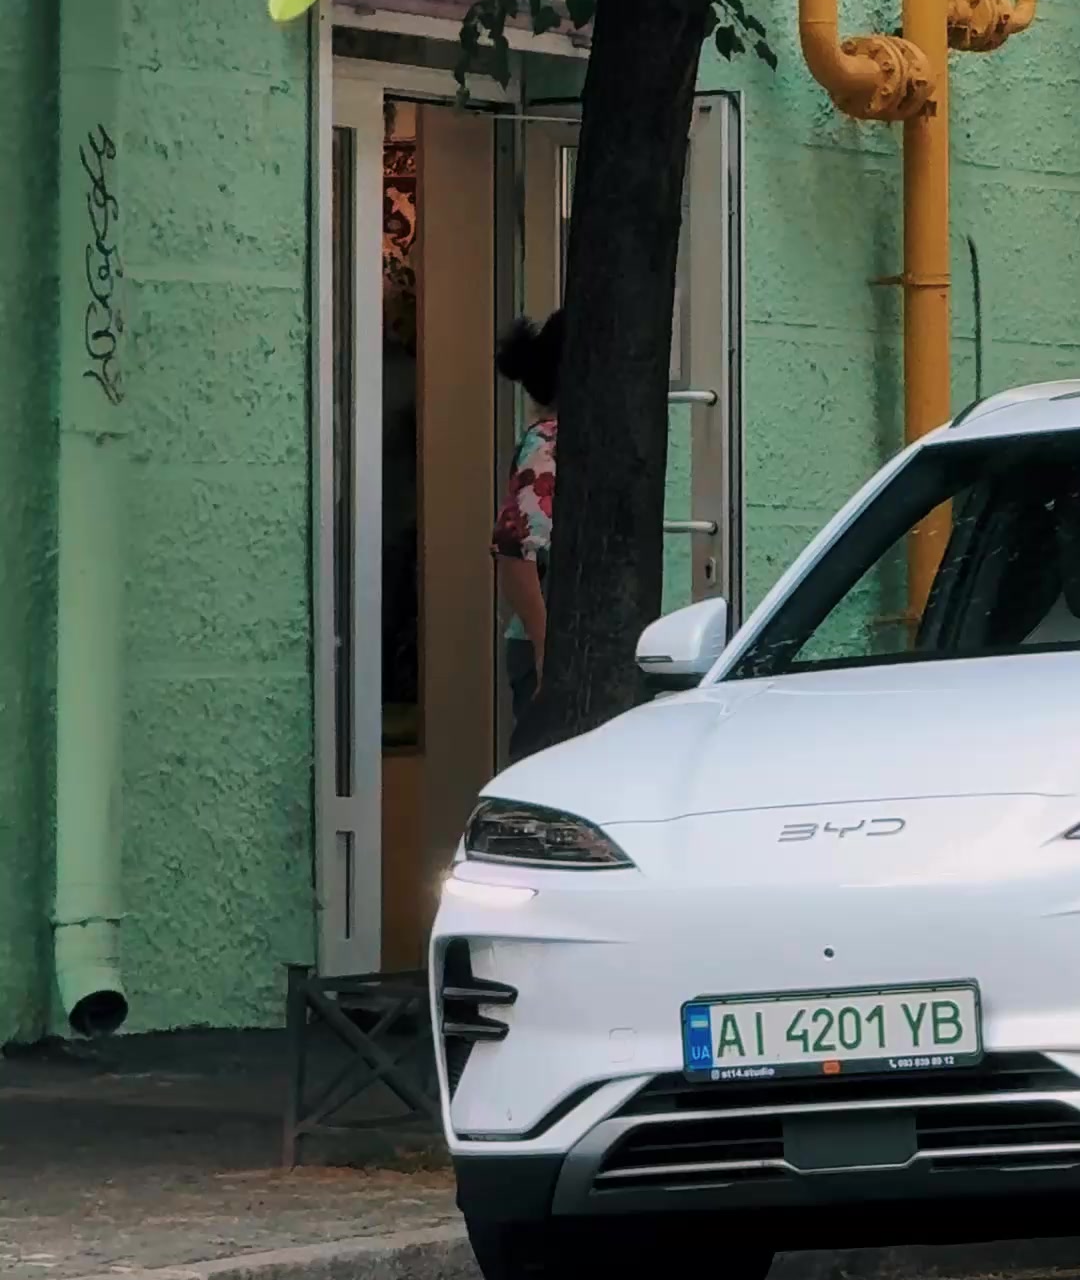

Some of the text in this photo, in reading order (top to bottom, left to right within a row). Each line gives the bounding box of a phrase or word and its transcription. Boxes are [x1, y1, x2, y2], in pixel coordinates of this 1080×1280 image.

[777, 817, 906, 843] BYD
[717, 1000, 963, 1058] AI 4201 YB
[691, 1045, 710, 1060] UA
